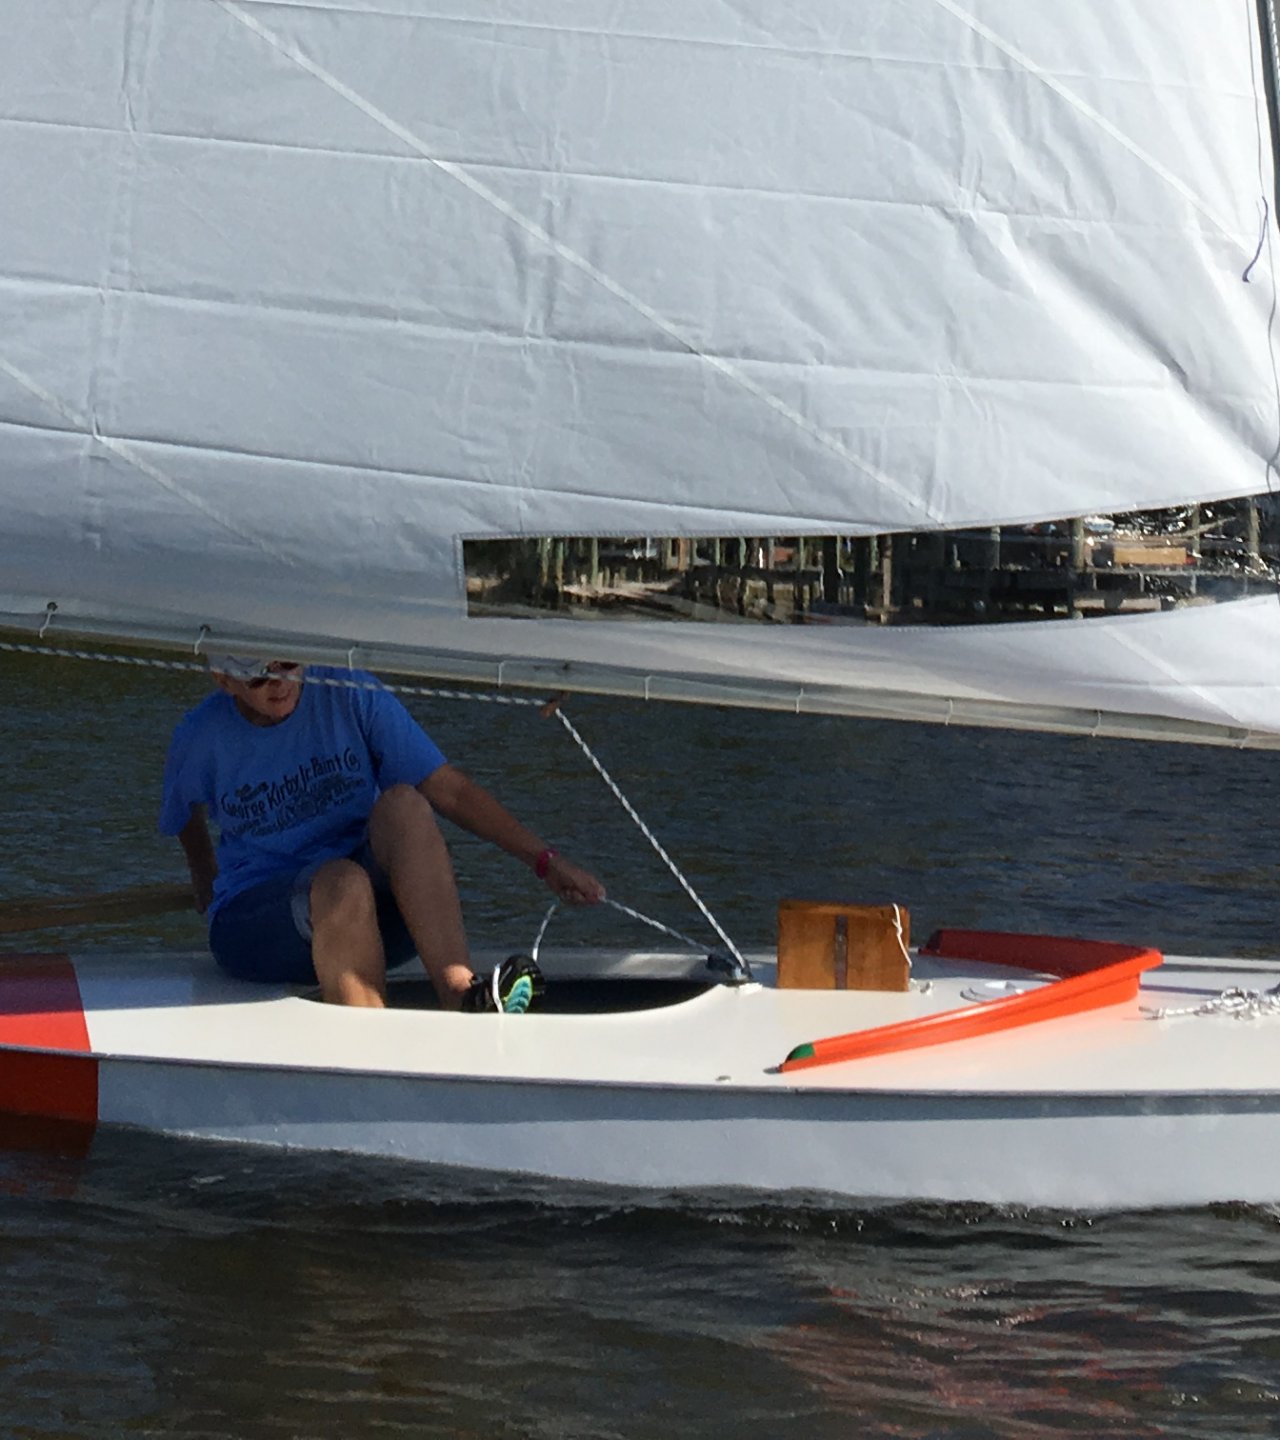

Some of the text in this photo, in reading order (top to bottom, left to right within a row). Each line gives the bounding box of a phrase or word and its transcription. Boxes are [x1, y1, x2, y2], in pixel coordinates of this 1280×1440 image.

[221, 791, 266, 820] George
[266, 773, 298, 809] Kirby
[310, 755, 344, 778] Paint
